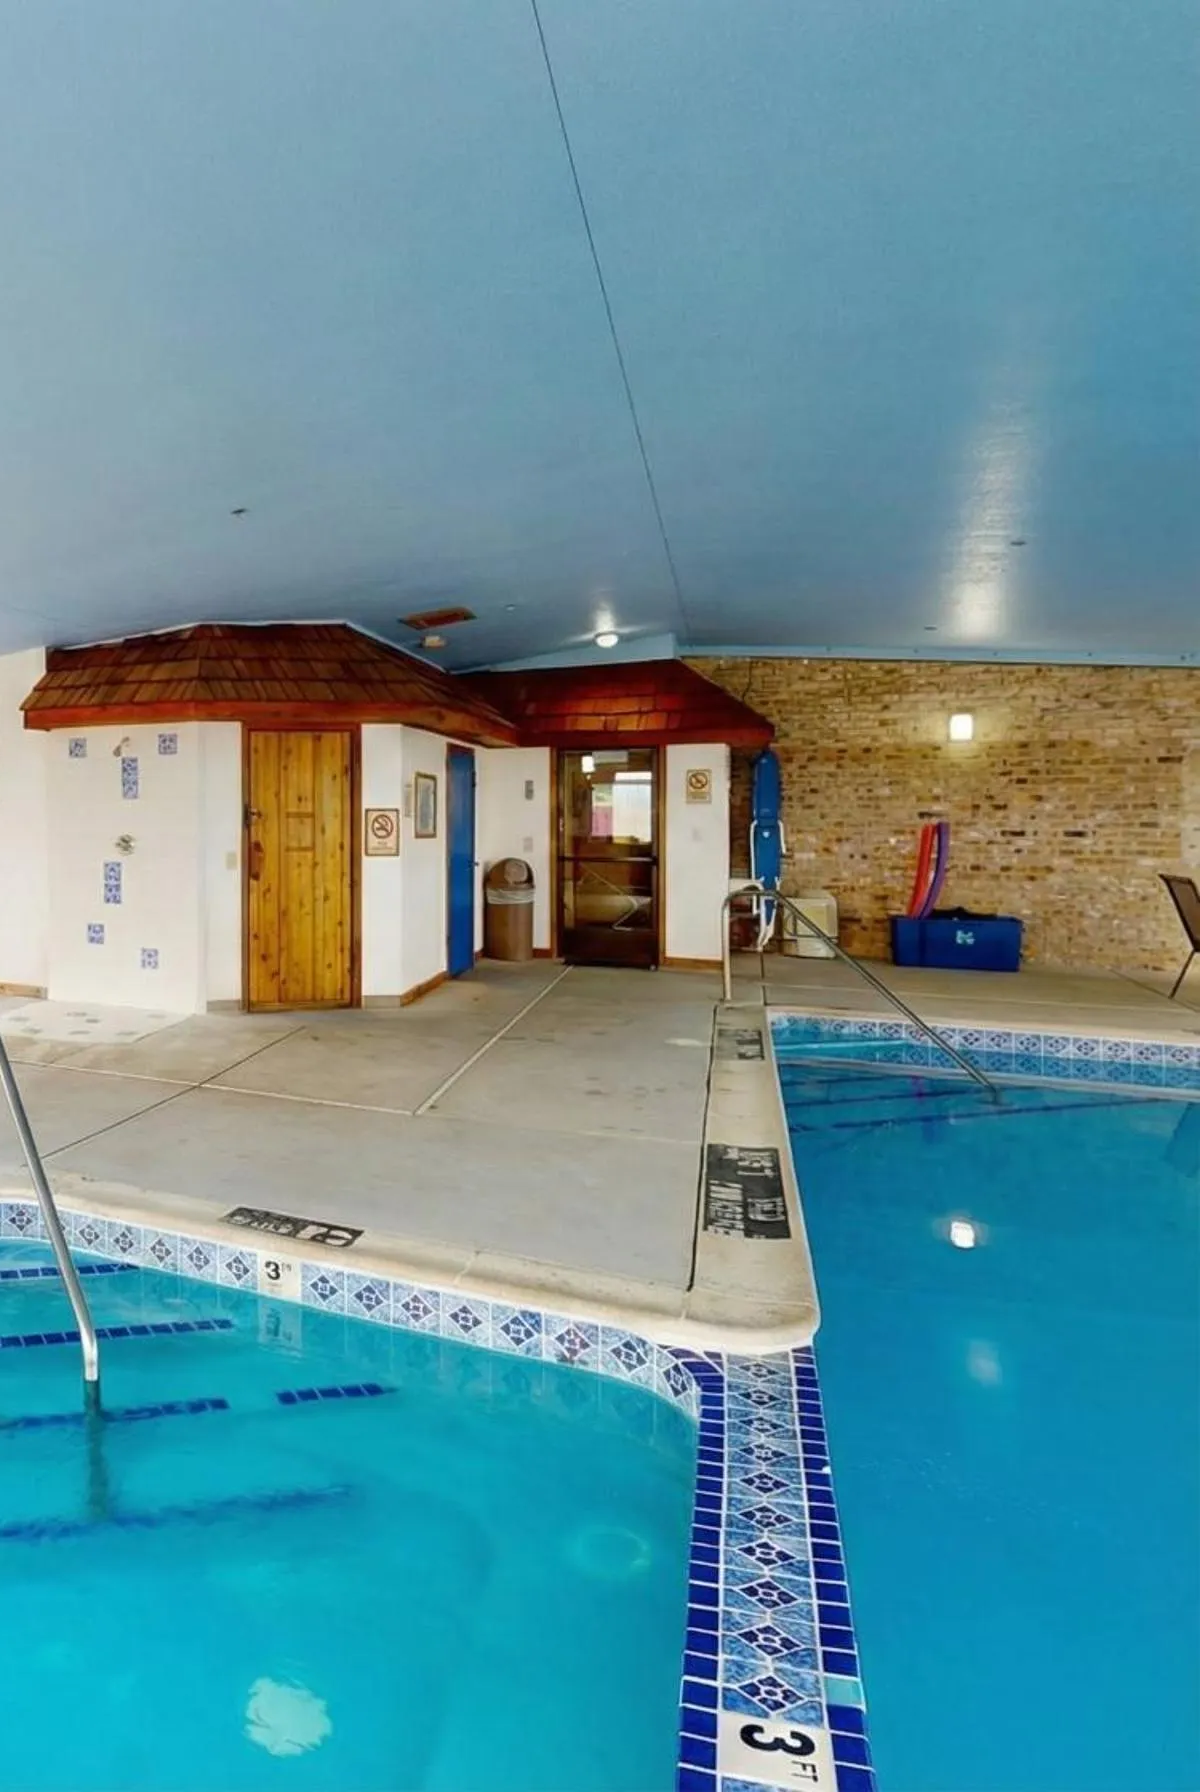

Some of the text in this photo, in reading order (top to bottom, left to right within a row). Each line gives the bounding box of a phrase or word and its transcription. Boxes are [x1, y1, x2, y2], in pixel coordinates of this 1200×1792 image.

[264, 1260, 281, 1281] 3
[740, 1724, 816, 1757] 3
[791, 1760, 819, 1783] FT
